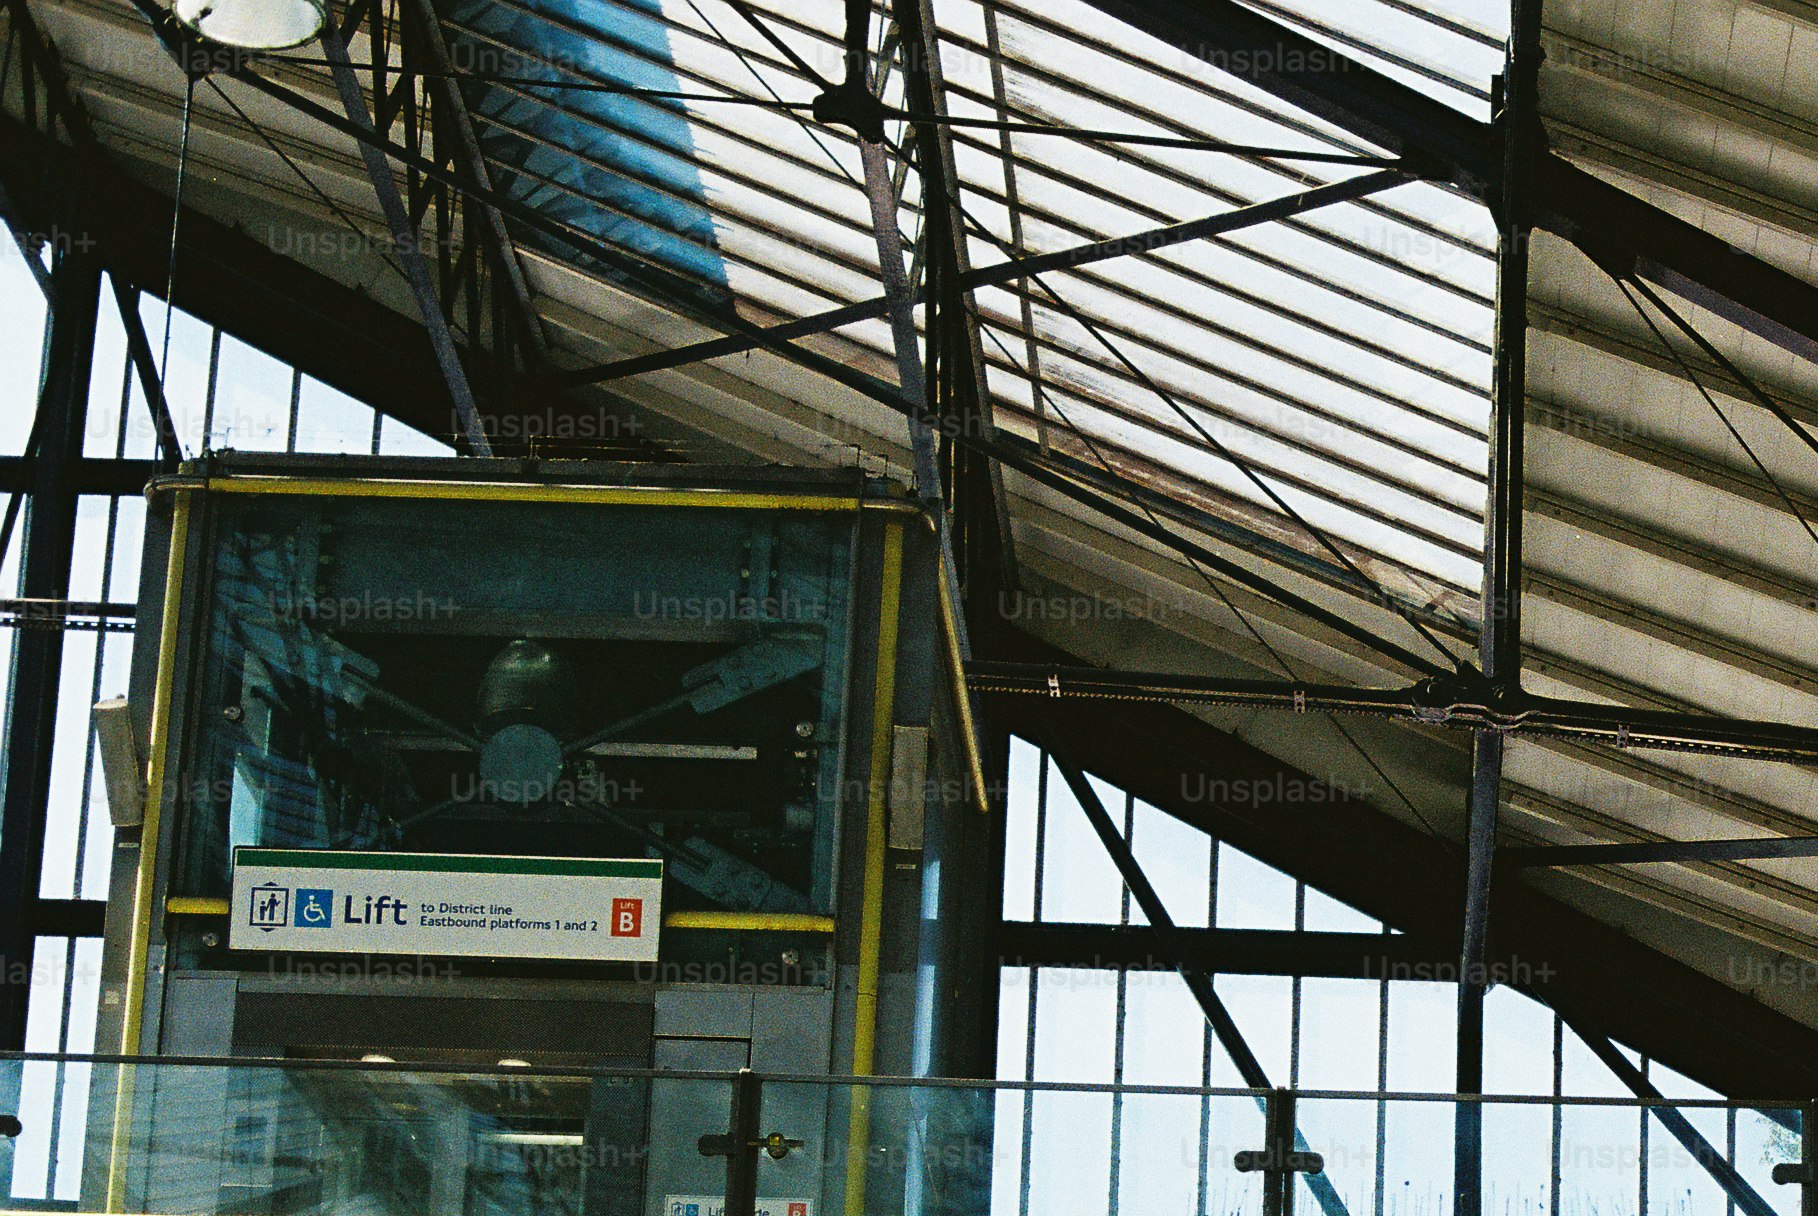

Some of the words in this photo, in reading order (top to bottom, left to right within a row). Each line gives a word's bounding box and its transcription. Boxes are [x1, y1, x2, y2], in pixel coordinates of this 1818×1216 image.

[344, 894, 408, 926] Lift
[421, 902, 435, 914] to
[438, 902, 486, 915] District
[490, 903, 513, 916] line
[620, 900, 635, 910] Lift
[420, 915, 487, 929] Eastbound
[490, 916, 551, 932] platforms
[564, 920, 586, 931] and
[590, 920, 598, 932] 2
[619, 910, 634, 932] B
